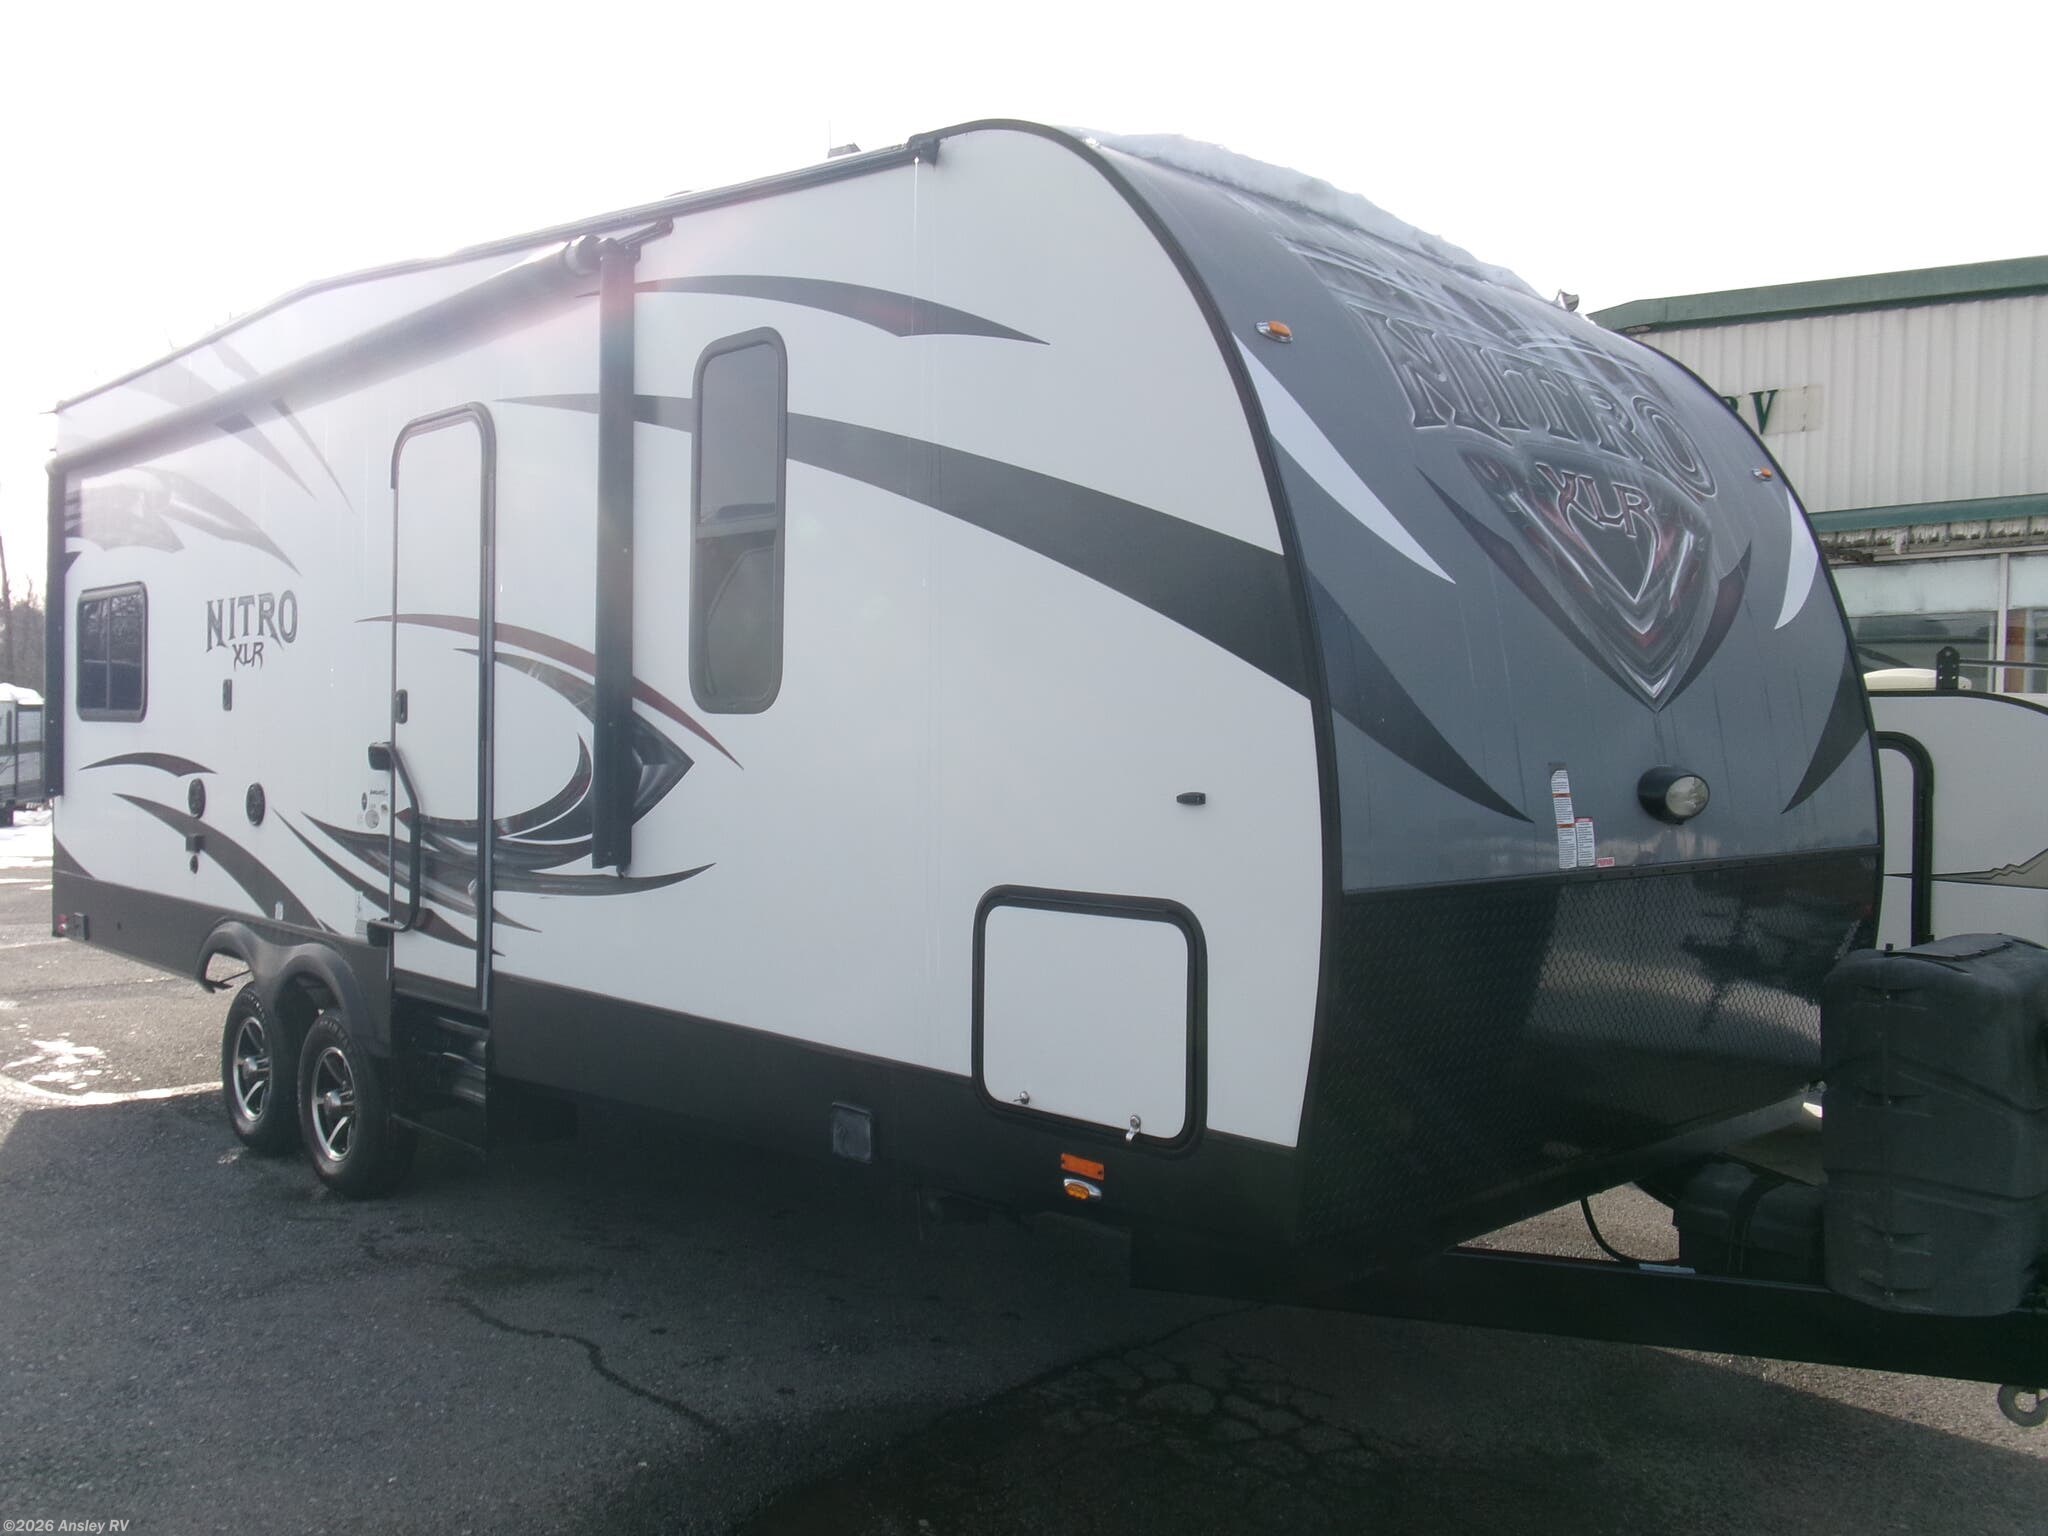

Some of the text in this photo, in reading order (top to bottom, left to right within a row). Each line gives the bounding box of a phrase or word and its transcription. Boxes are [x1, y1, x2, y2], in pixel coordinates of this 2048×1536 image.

[1349, 303, 1718, 500] NITRO
[1535, 461, 1660, 570] XLR
[206, 590, 298, 652] NITRO
[232, 642, 264, 671] XLR
